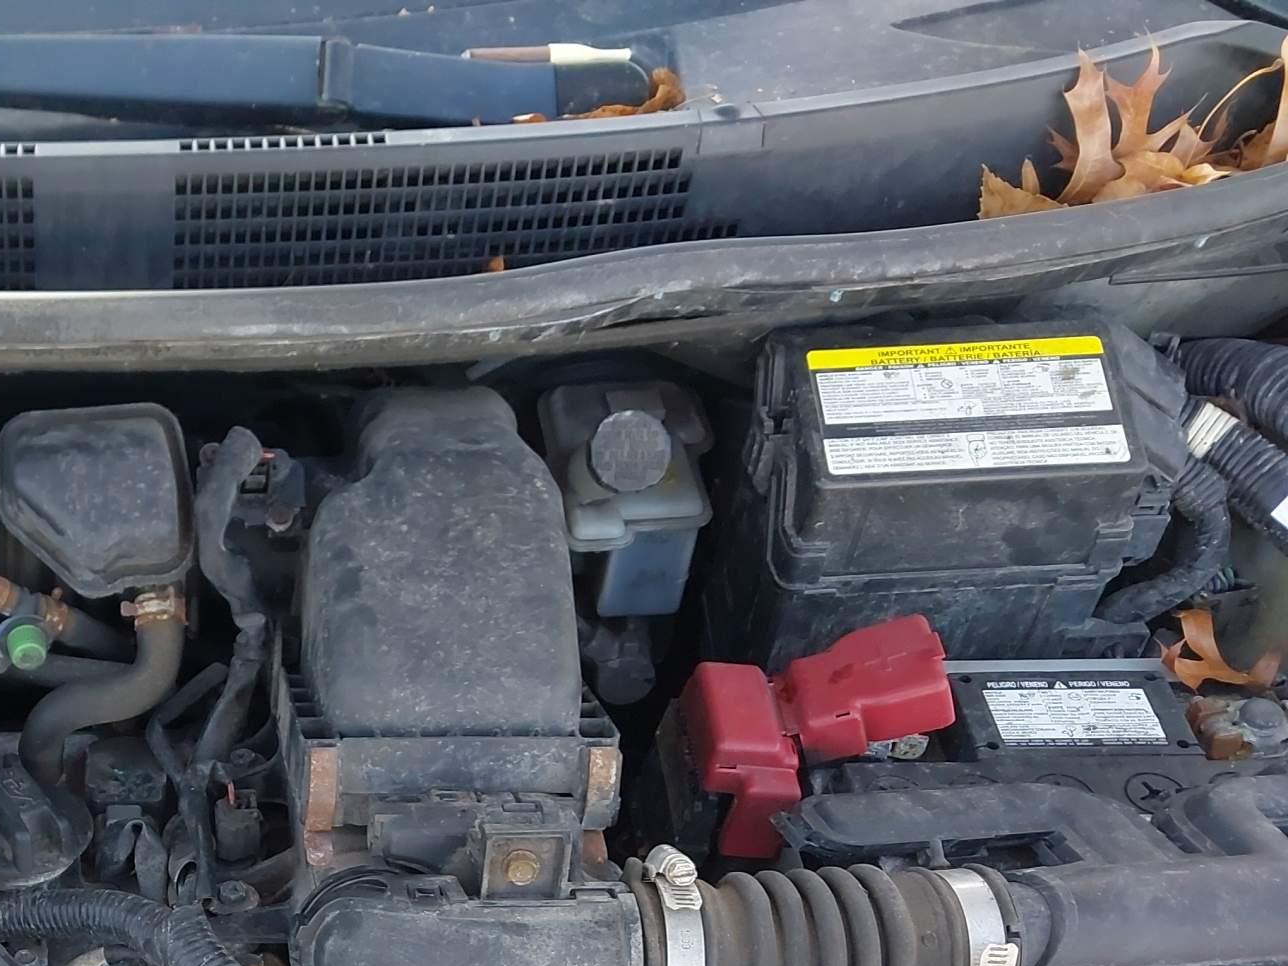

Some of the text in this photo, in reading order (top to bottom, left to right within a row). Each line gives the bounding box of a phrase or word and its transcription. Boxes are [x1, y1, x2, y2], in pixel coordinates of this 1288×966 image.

[870, 356, 921, 366] BATTERY
[929, 353, 983, 363] BATTERIE
[992, 348, 1041, 358] BATERÍA
[878, 342, 1031, 358] IMPORTANT IMPORTANTE
[986, 681, 1016, 689] PELIGRO
[1100, 680, 1130, 688] VENENO
